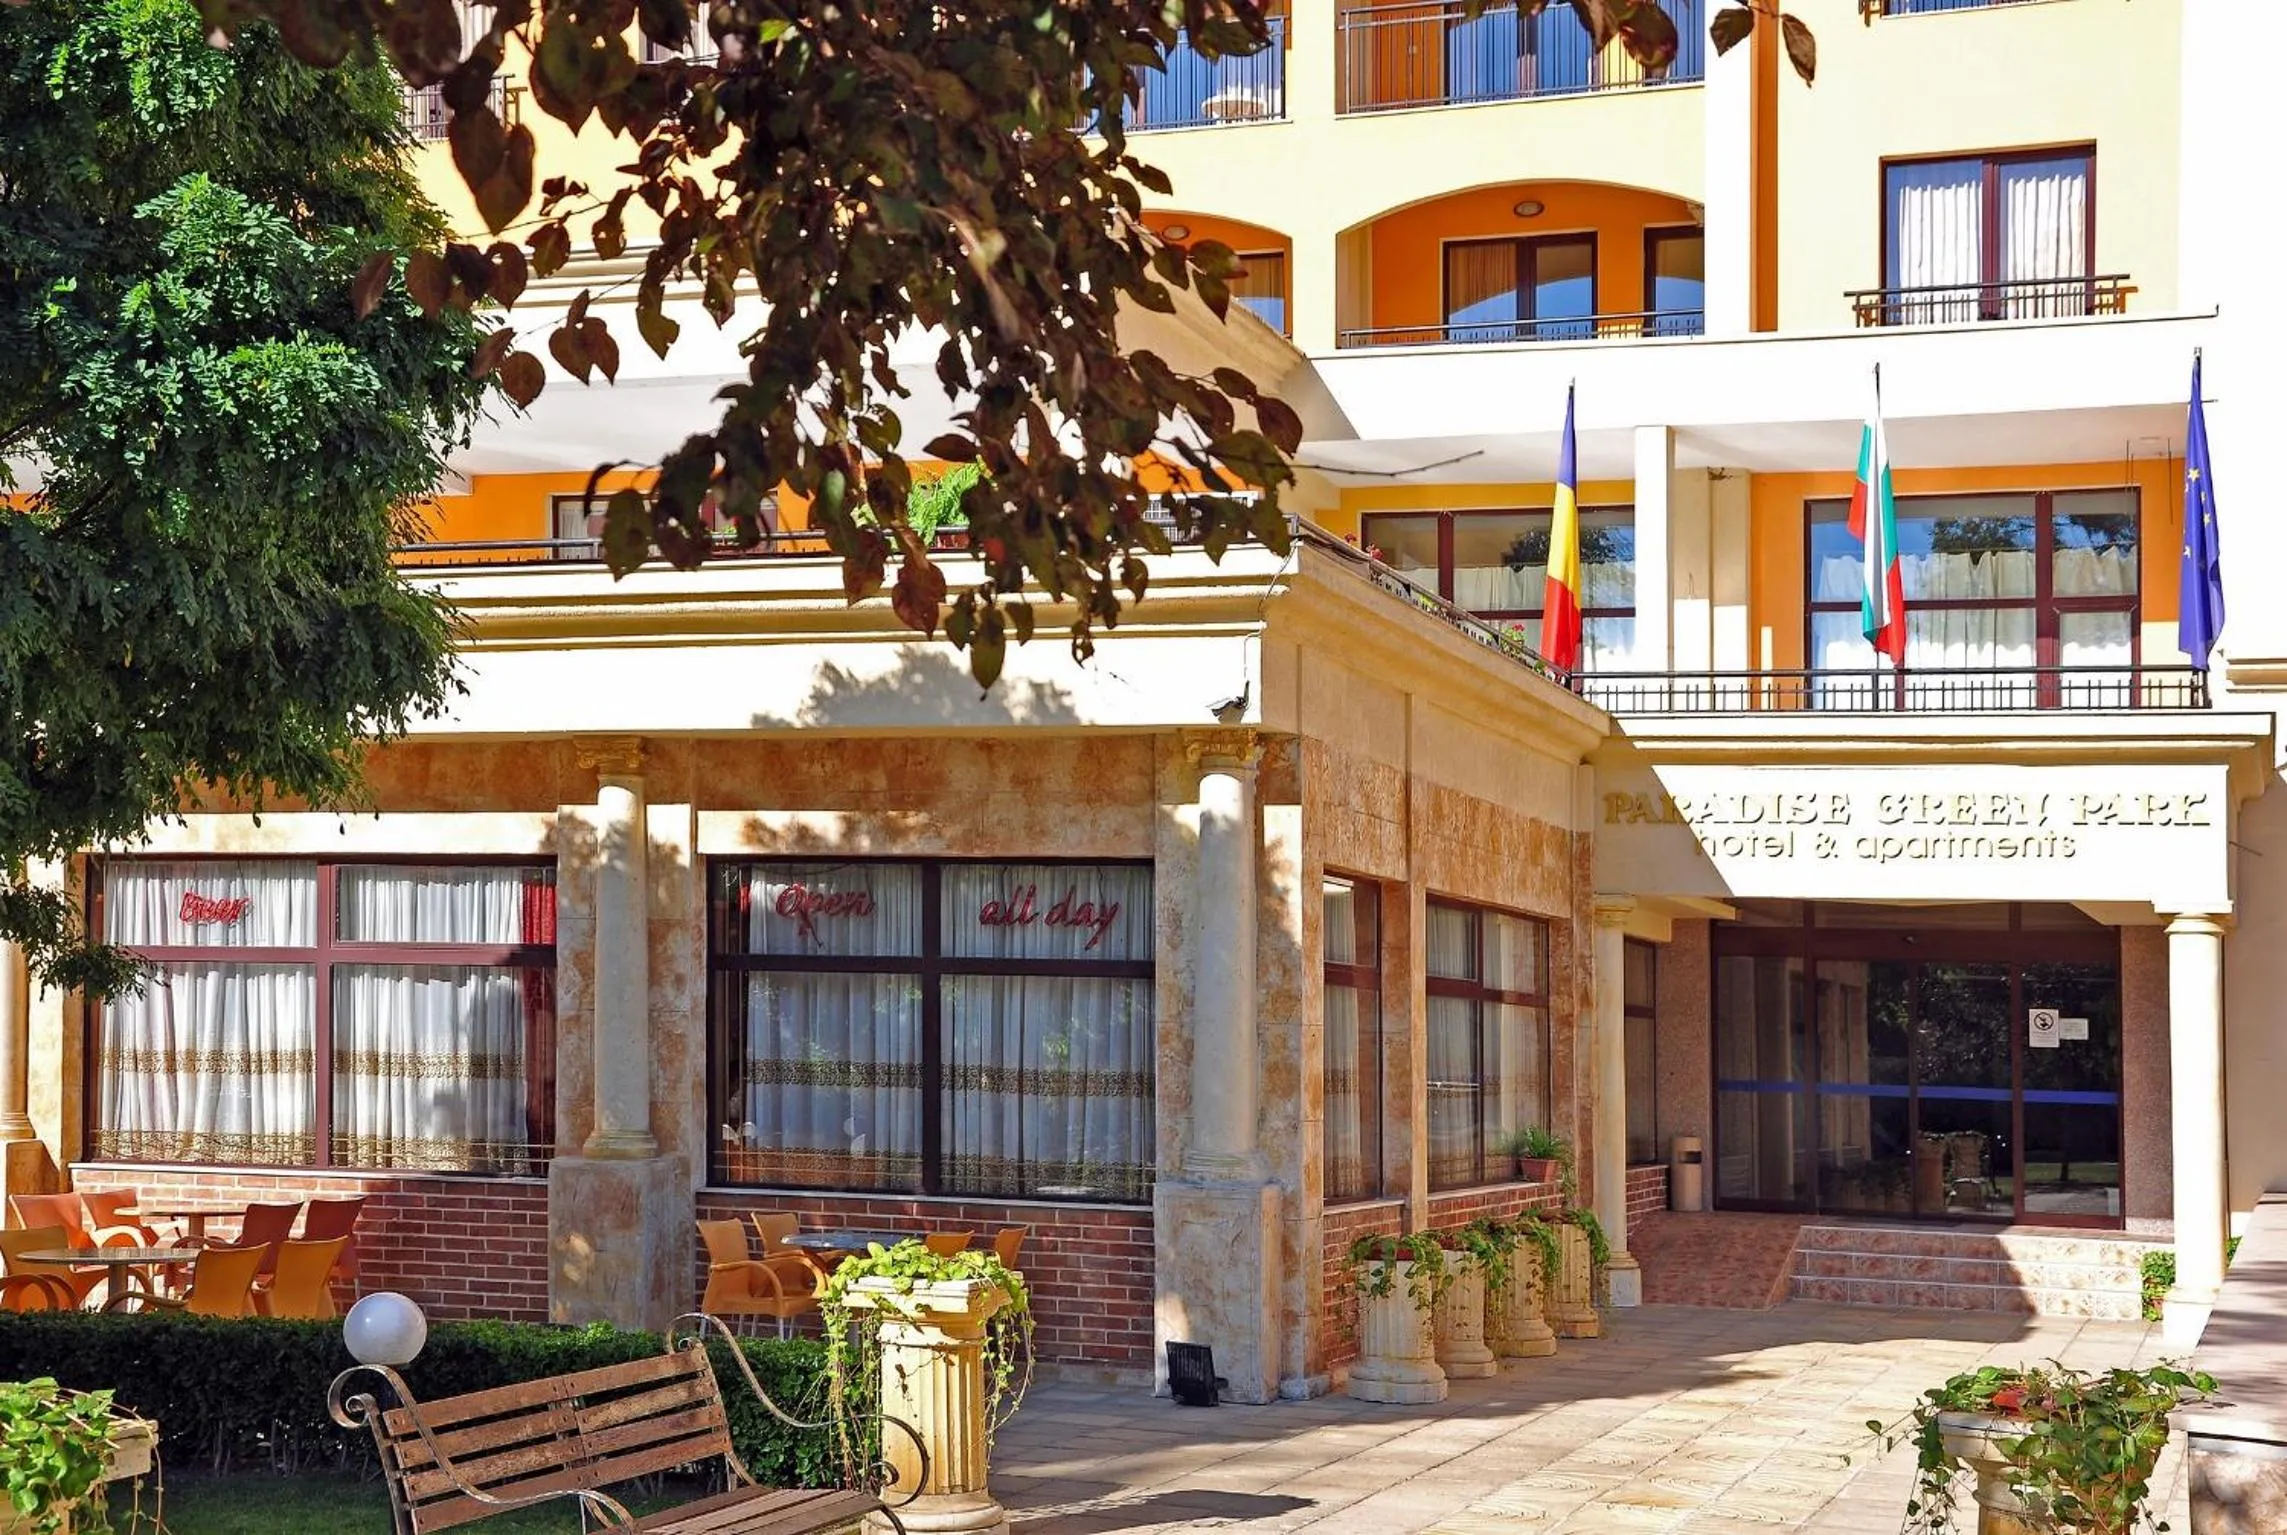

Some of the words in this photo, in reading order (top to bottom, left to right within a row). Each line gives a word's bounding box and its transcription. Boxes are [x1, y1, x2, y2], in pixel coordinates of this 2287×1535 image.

[1603, 790, 1851, 826] PARADISE
[1877, 793, 2050, 827] GREEN
[2070, 793, 2211, 827] PARK
[1697, 830, 1795, 858] hotel
[1815, 832, 1838, 859] &
[1855, 830, 2077, 864] apartments
[776, 881, 875, 937] Open
[979, 884, 1040, 927] all
[1044, 884, 1121, 951] day
